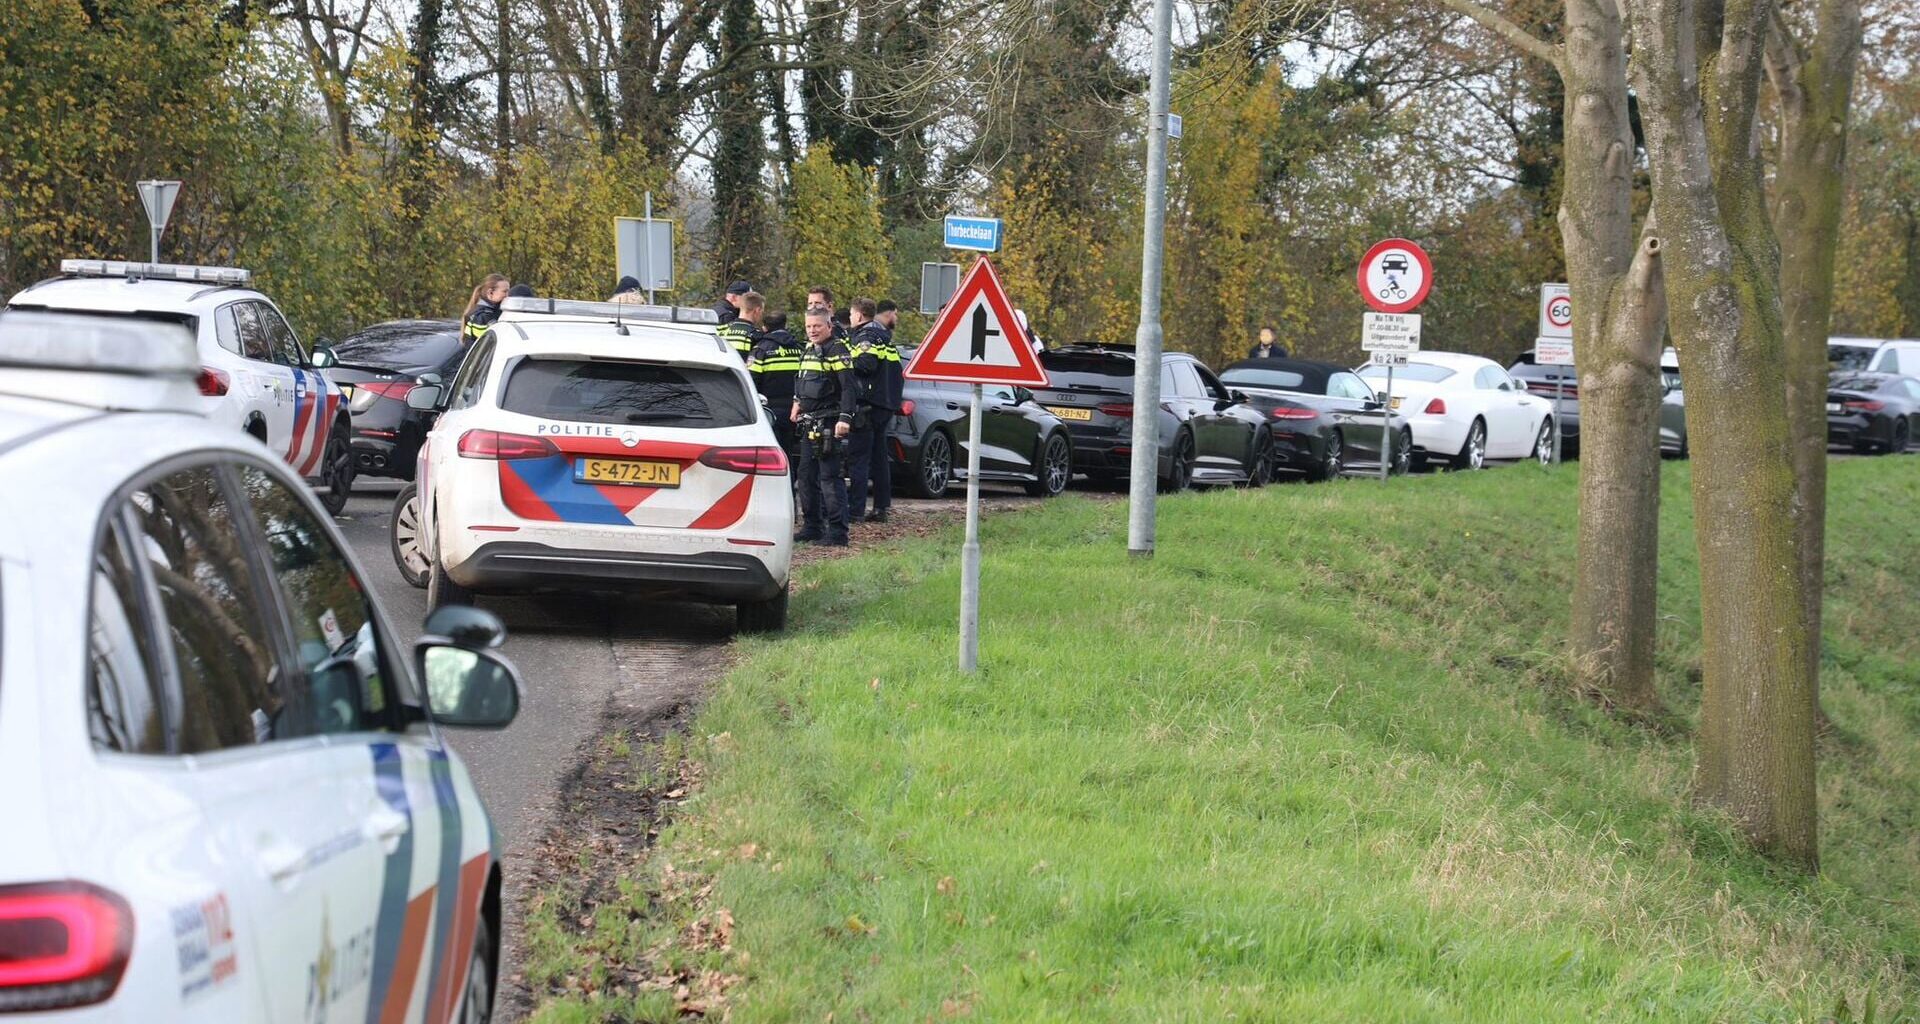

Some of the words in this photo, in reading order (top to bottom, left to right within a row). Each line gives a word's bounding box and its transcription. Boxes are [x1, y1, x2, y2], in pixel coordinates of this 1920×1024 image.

[947, 221, 992, 241] Thorbeckelaan
[1552, 305, 1571, 317] 60
[1386, 353, 1392, 364] 2
[1393, 353, 1407, 365] km
[538, 424, 613, 436] POLITIE
[590, 461, 671, 482] S-472-JN
